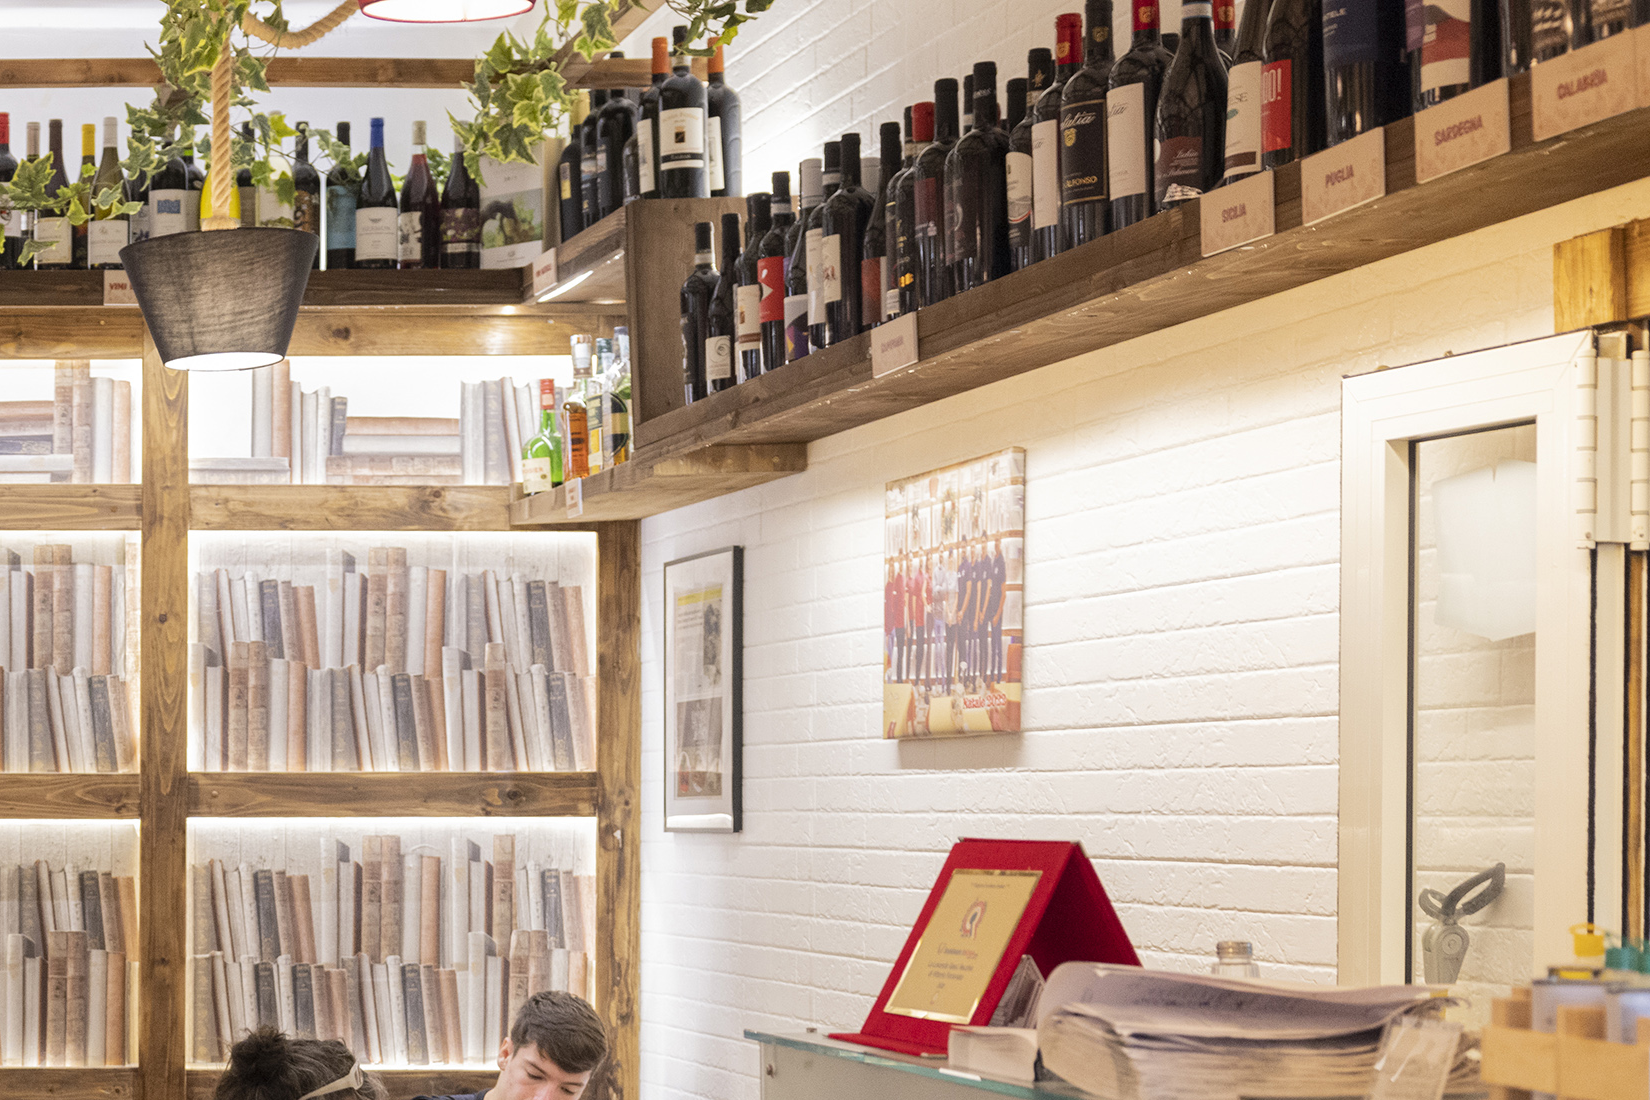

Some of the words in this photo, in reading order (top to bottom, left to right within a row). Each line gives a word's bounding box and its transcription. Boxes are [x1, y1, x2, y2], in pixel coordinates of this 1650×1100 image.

[1556, 68, 1608, 100] CALABRIA
[1434, 114, 1483, 147] SARDEGNA
[1324, 164, 1355, 188] PUGLIA
[109, 282, 131, 291] VINI
